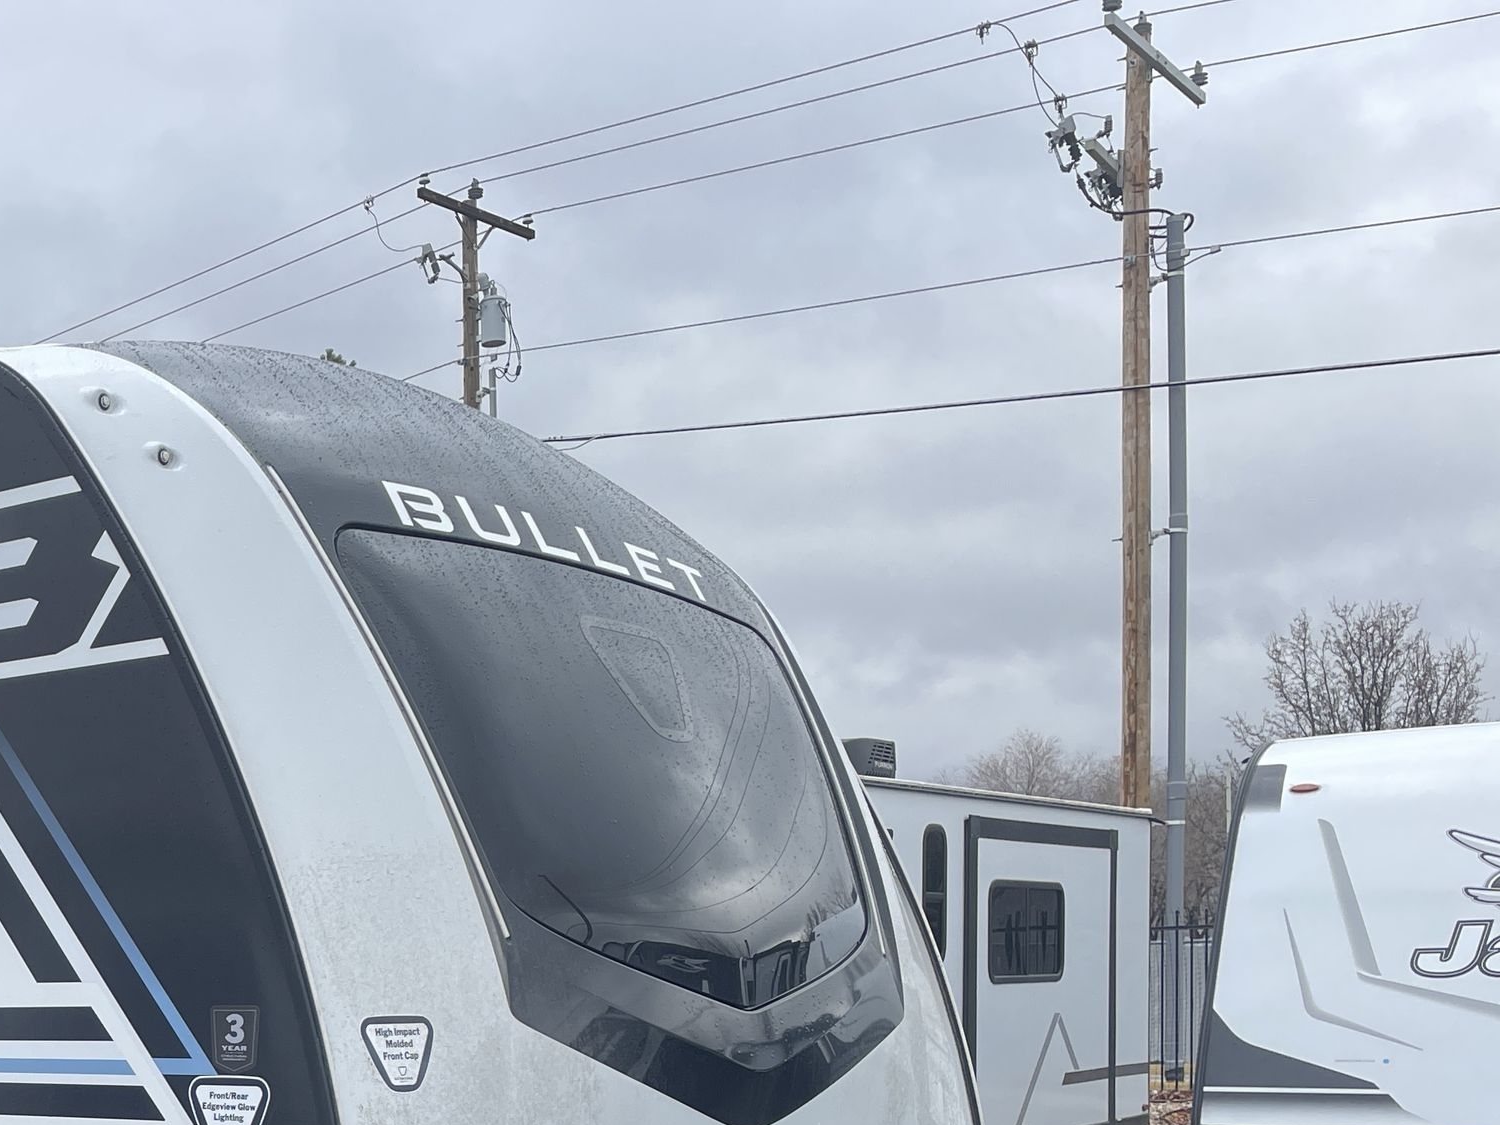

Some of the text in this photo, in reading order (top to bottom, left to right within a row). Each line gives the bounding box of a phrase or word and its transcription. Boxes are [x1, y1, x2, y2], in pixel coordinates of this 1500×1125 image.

[381, 480, 707, 602] BULLET
[224, 1013, 245, 1044] 3
[375, 1027, 420, 1038] High Impact
[385, 1039, 414, 1048] Molded
[383, 1050, 419, 1060] Front Cap
[209, 1091, 249, 1100] Front/Rear
[202, 1102, 256, 1111] Edgeview Glow
[213, 1113, 244, 1123] Lighting
